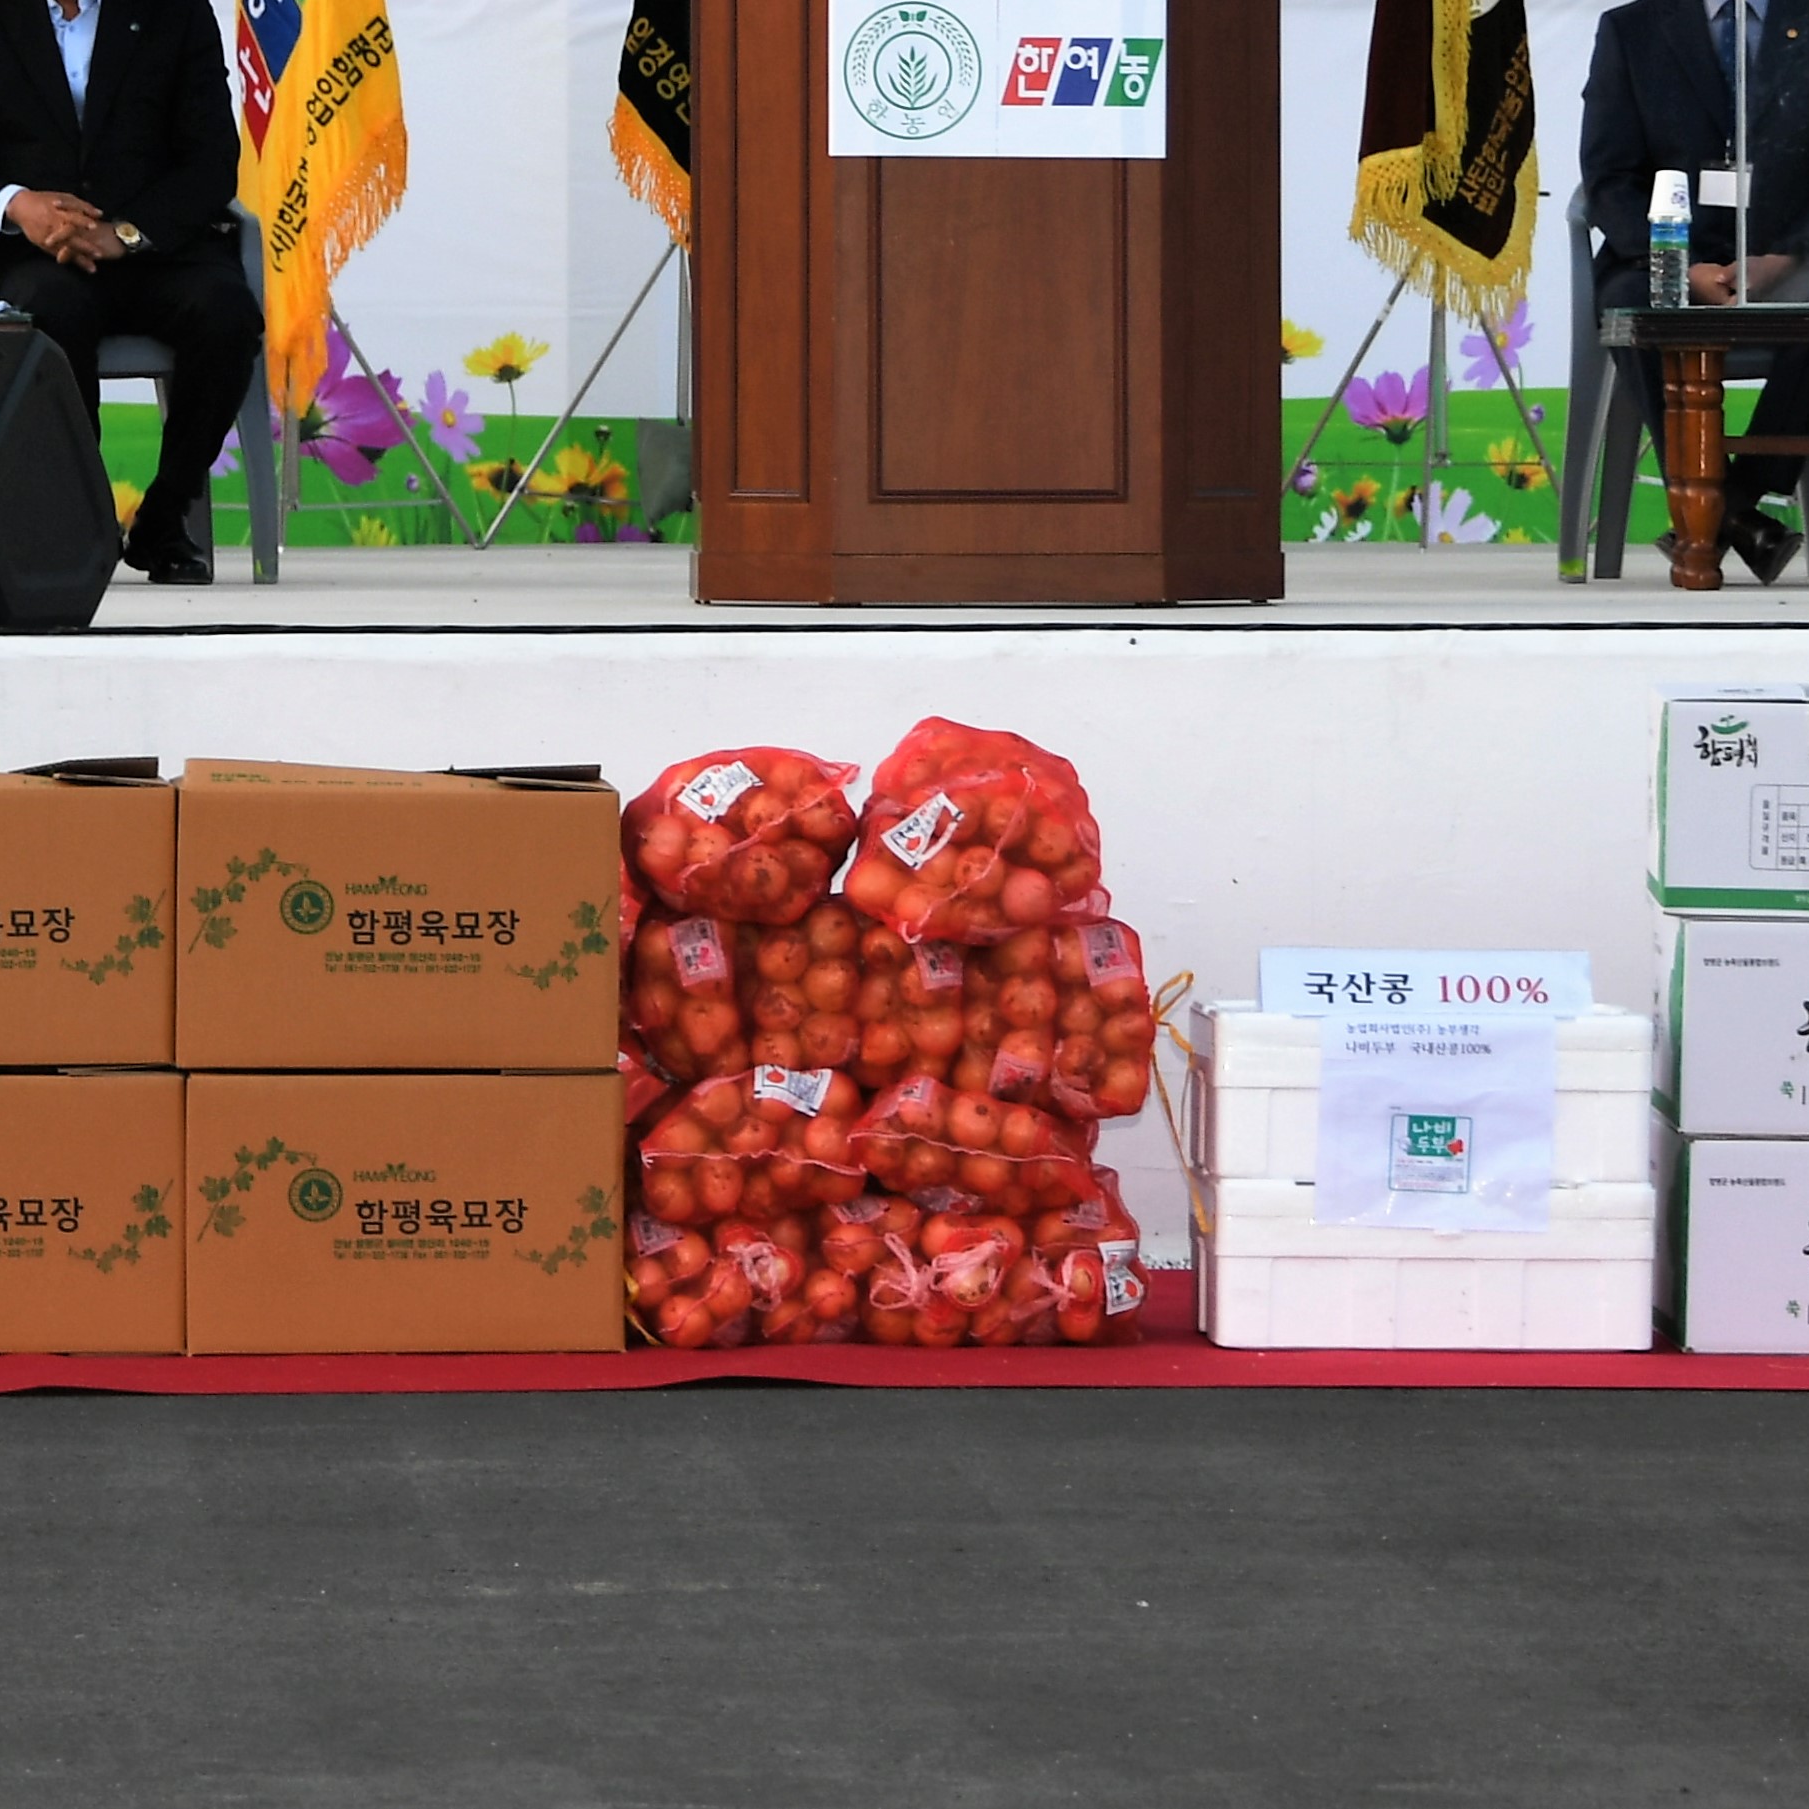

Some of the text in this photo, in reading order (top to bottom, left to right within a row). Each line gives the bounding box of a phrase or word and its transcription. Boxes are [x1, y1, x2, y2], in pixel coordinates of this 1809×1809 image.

[1006, 38, 1157, 104] 한여농
[347, 910, 521, 948] 함평육묘장
[1303, 971, 1549, 1006] 국산콩 100%
[1412, 1120, 1452, 1134] 나비
[355, 1198, 529, 1236] 함평육묘장
